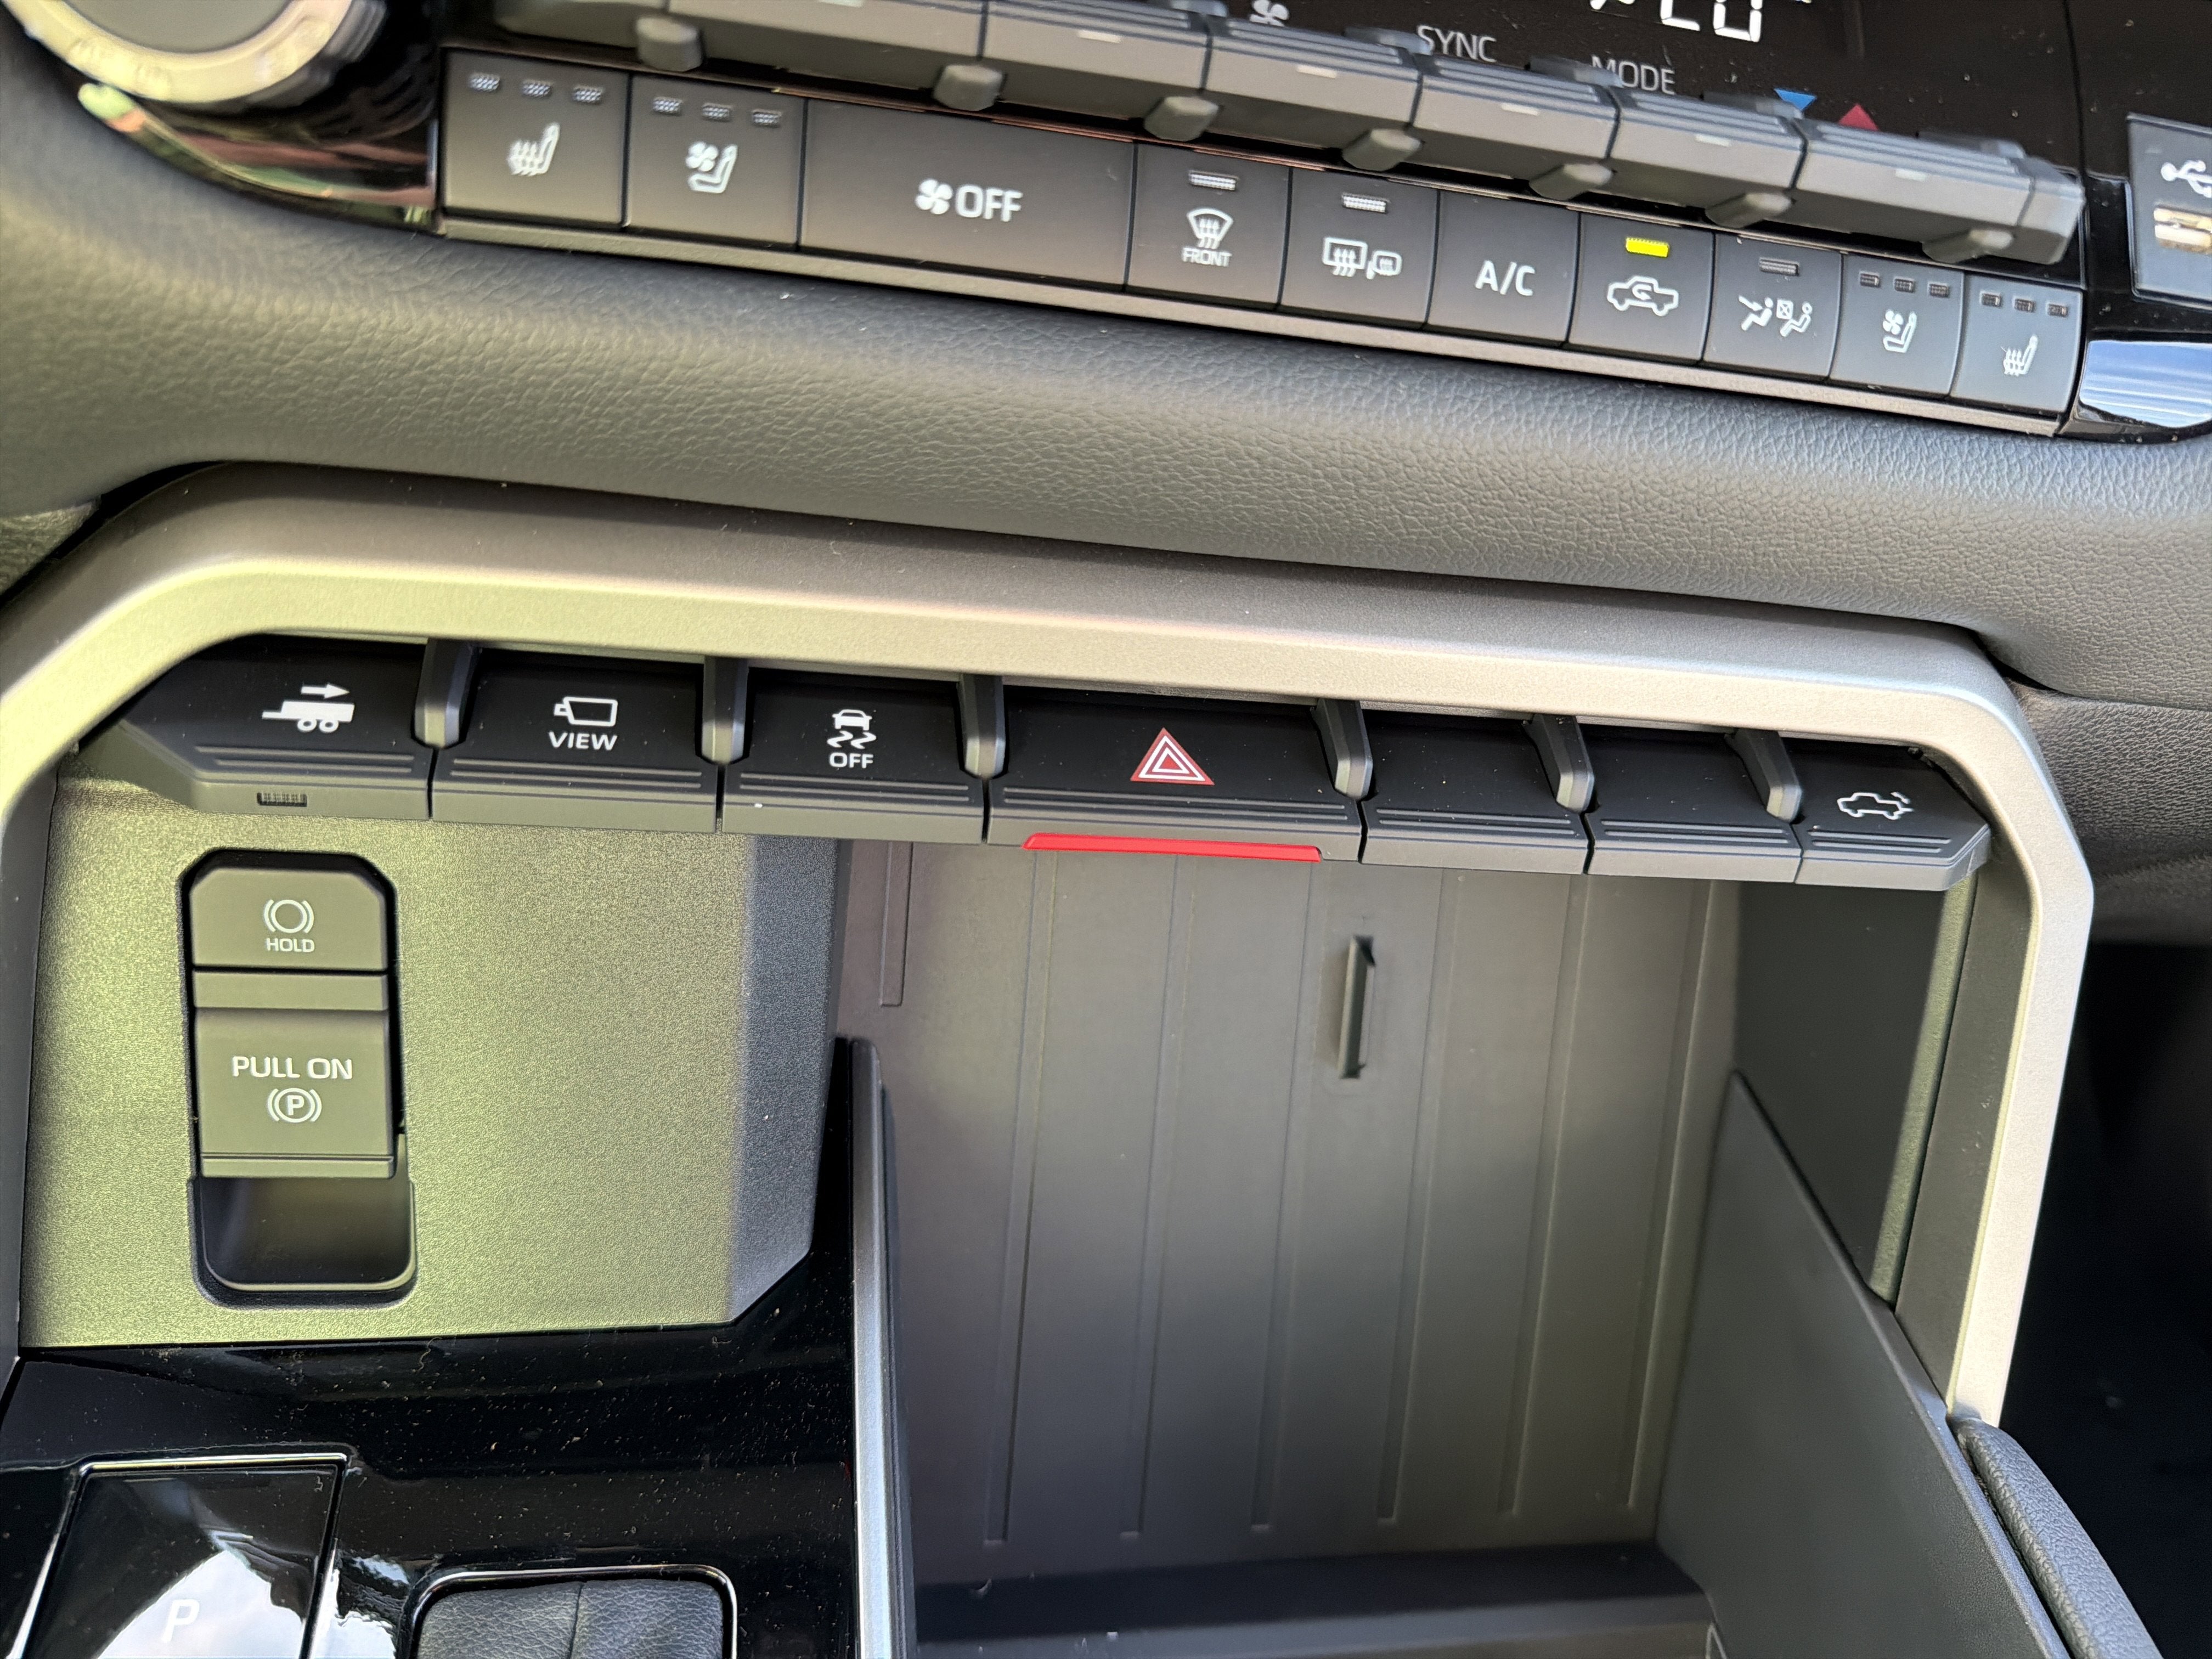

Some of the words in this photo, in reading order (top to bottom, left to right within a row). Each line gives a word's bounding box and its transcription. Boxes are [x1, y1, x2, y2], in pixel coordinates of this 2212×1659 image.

[1417, 25, 1497, 63] SYNC
[956, 184, 1023, 221] OFF
[1182, 246, 1232, 267] FRONT
[1475, 259, 1536, 297] A/C
[548, 730, 617, 751] VIEW
[829, 752, 873, 769] OFF
[266, 938, 315, 952] HOLD
[232, 1056, 300, 1079] PULL
[307, 1058, 353, 1080] ON
[287, 1096, 304, 1116] P
[161, 1599, 200, 1641] P
